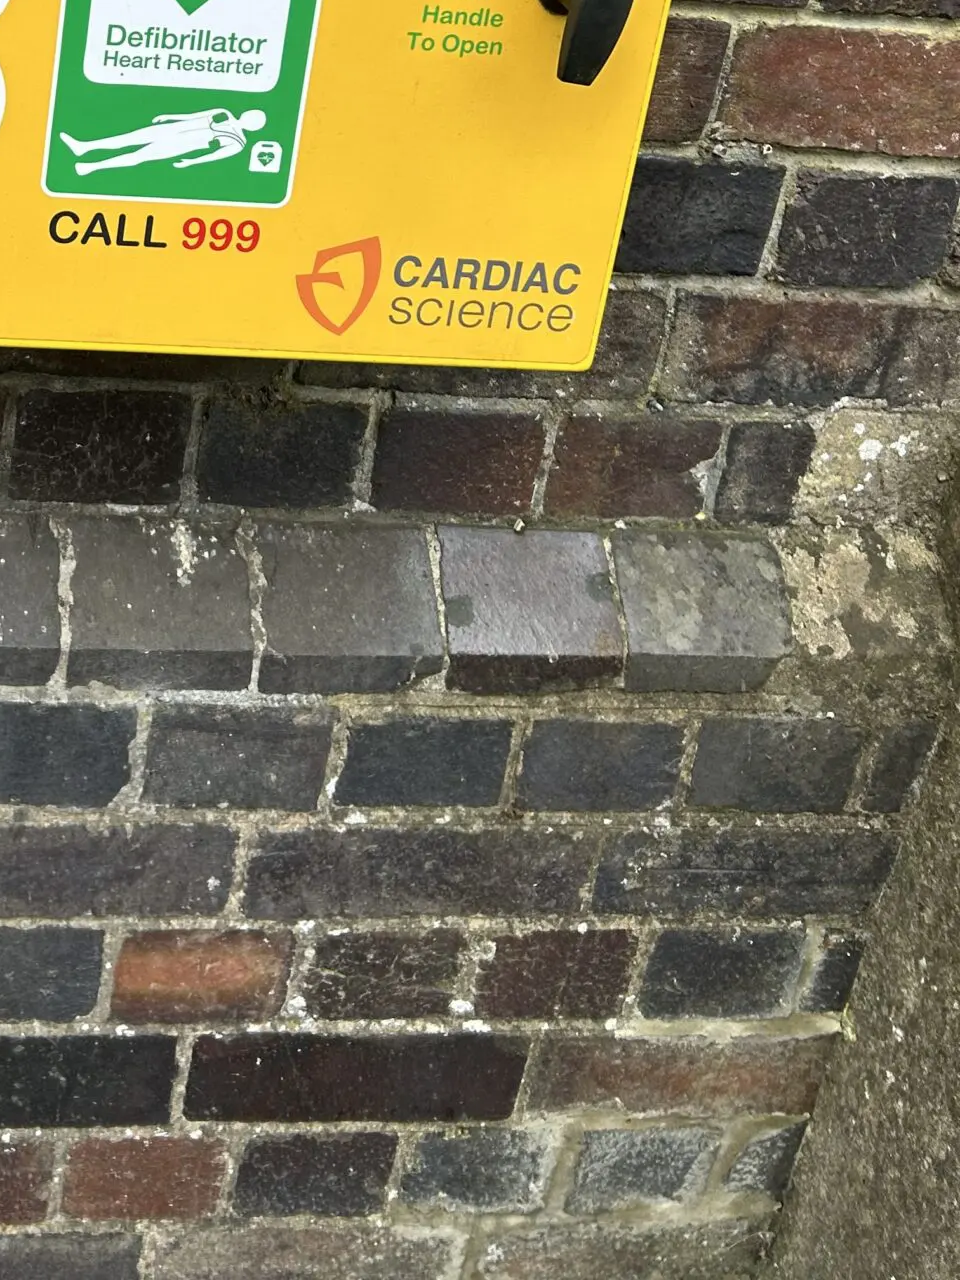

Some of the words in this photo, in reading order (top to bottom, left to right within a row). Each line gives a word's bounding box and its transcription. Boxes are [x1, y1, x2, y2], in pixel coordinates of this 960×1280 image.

[423, 6, 503, 27] Handle
[105, 24, 268, 55] Defibrillator
[409, 32, 434, 50] To
[443, 35, 502, 57] Open
[103, 50, 161, 70] Heart
[166, 53, 263, 75] Restarter
[49, 211, 167, 248] CALL
[182, 218, 260, 252] 999
[393, 255, 581, 294] CARDIAC
[388, 296, 573, 332] science
